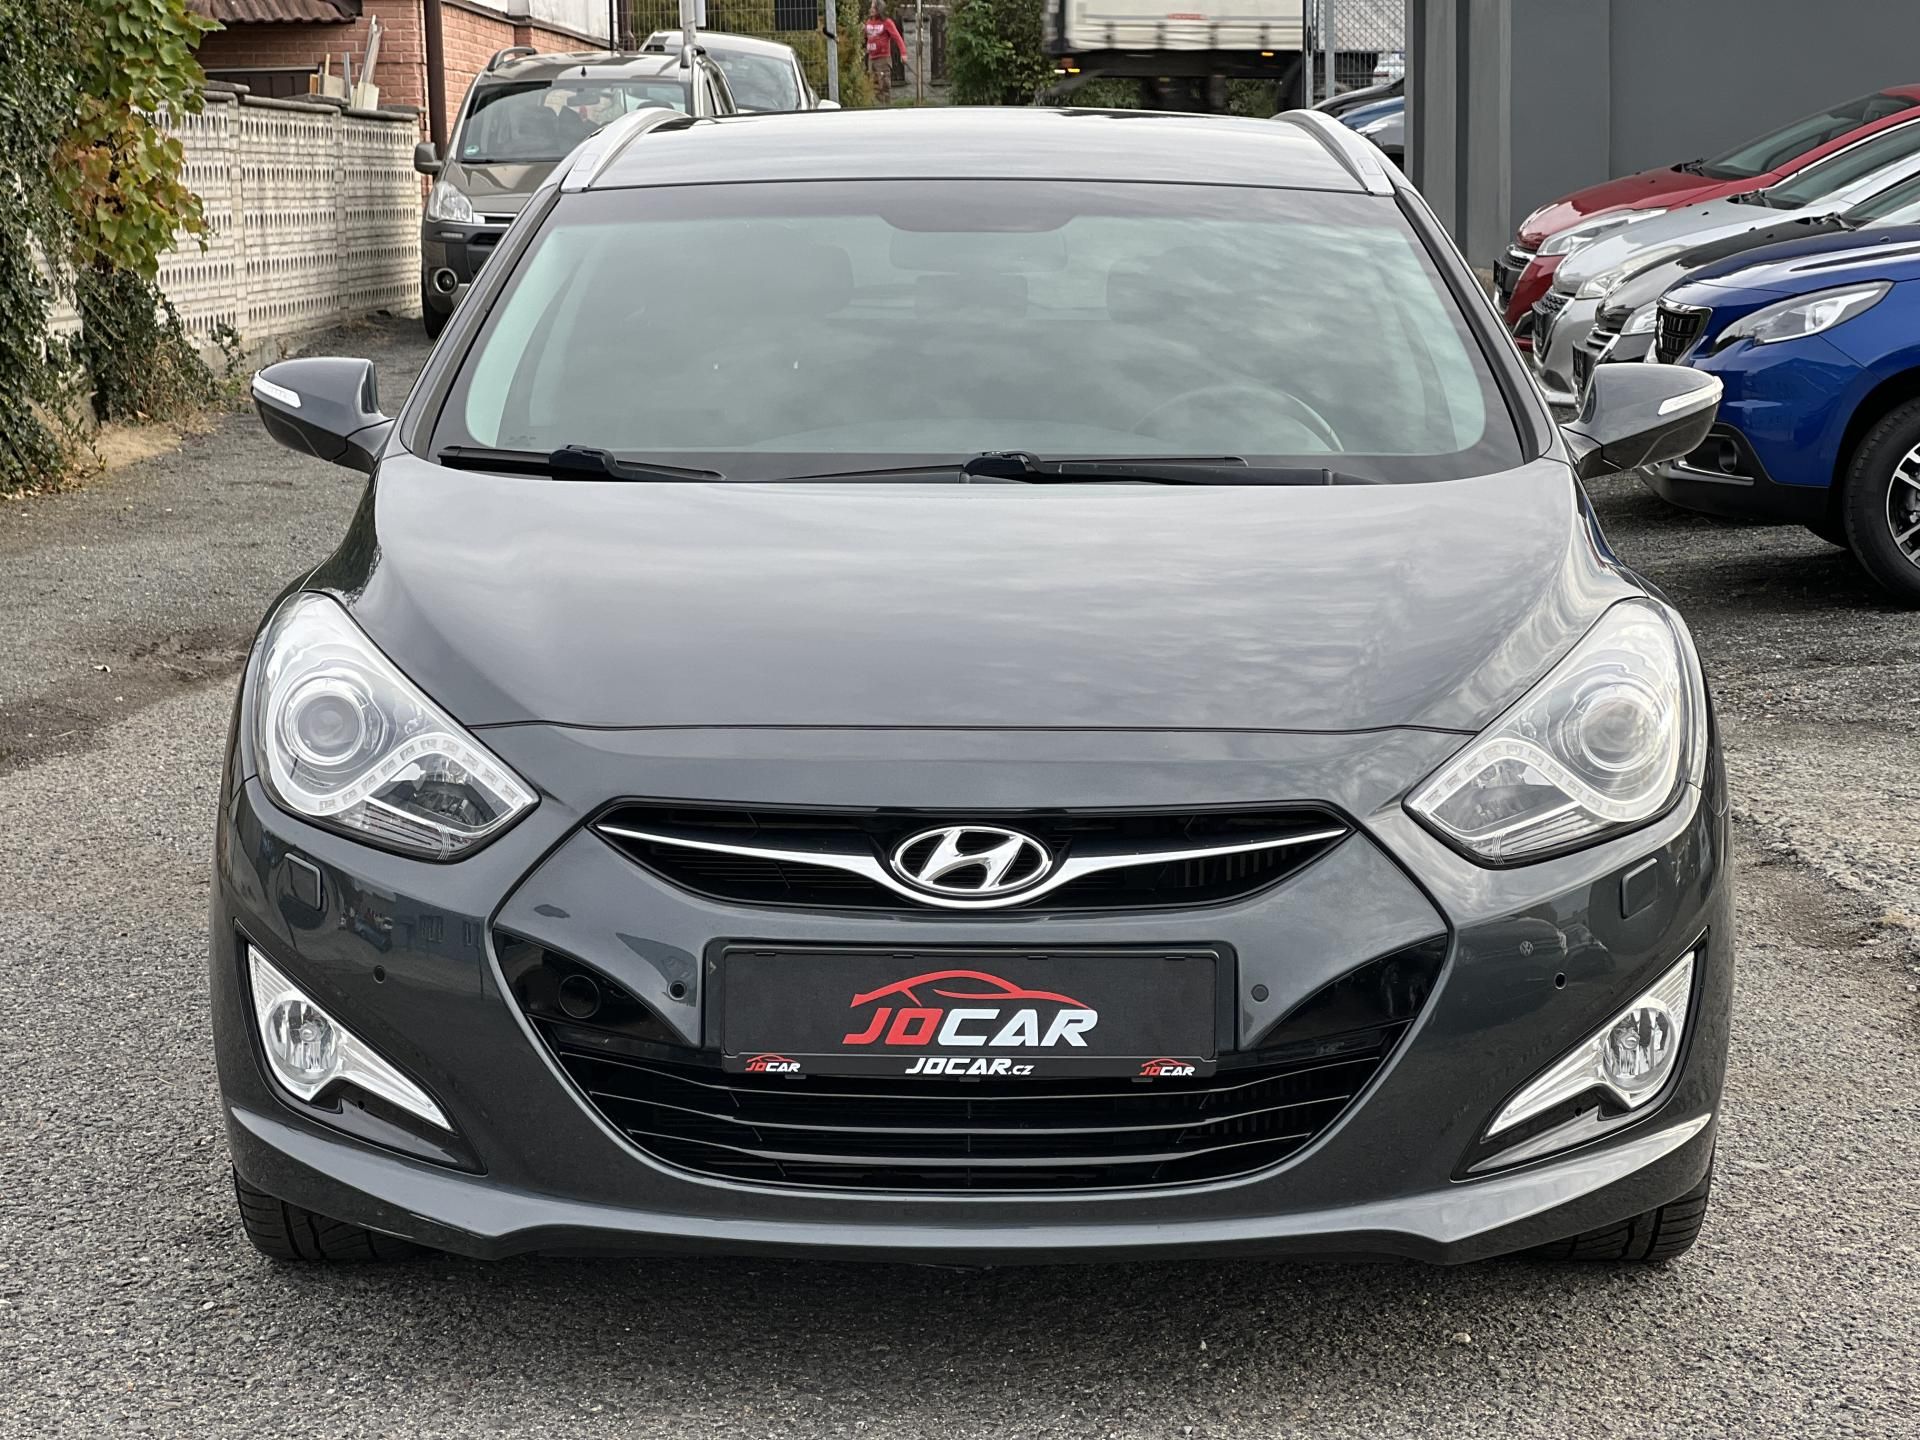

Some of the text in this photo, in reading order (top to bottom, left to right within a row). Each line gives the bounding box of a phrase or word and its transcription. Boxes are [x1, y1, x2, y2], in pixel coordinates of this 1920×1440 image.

[842, 1007, 1098, 1047] JOCAR
[745, 1062, 801, 1073] JOCAR
[904, 1057, 1035, 1076] JOCAR.cz
[1139, 1066, 1196, 1077] JOCAR
